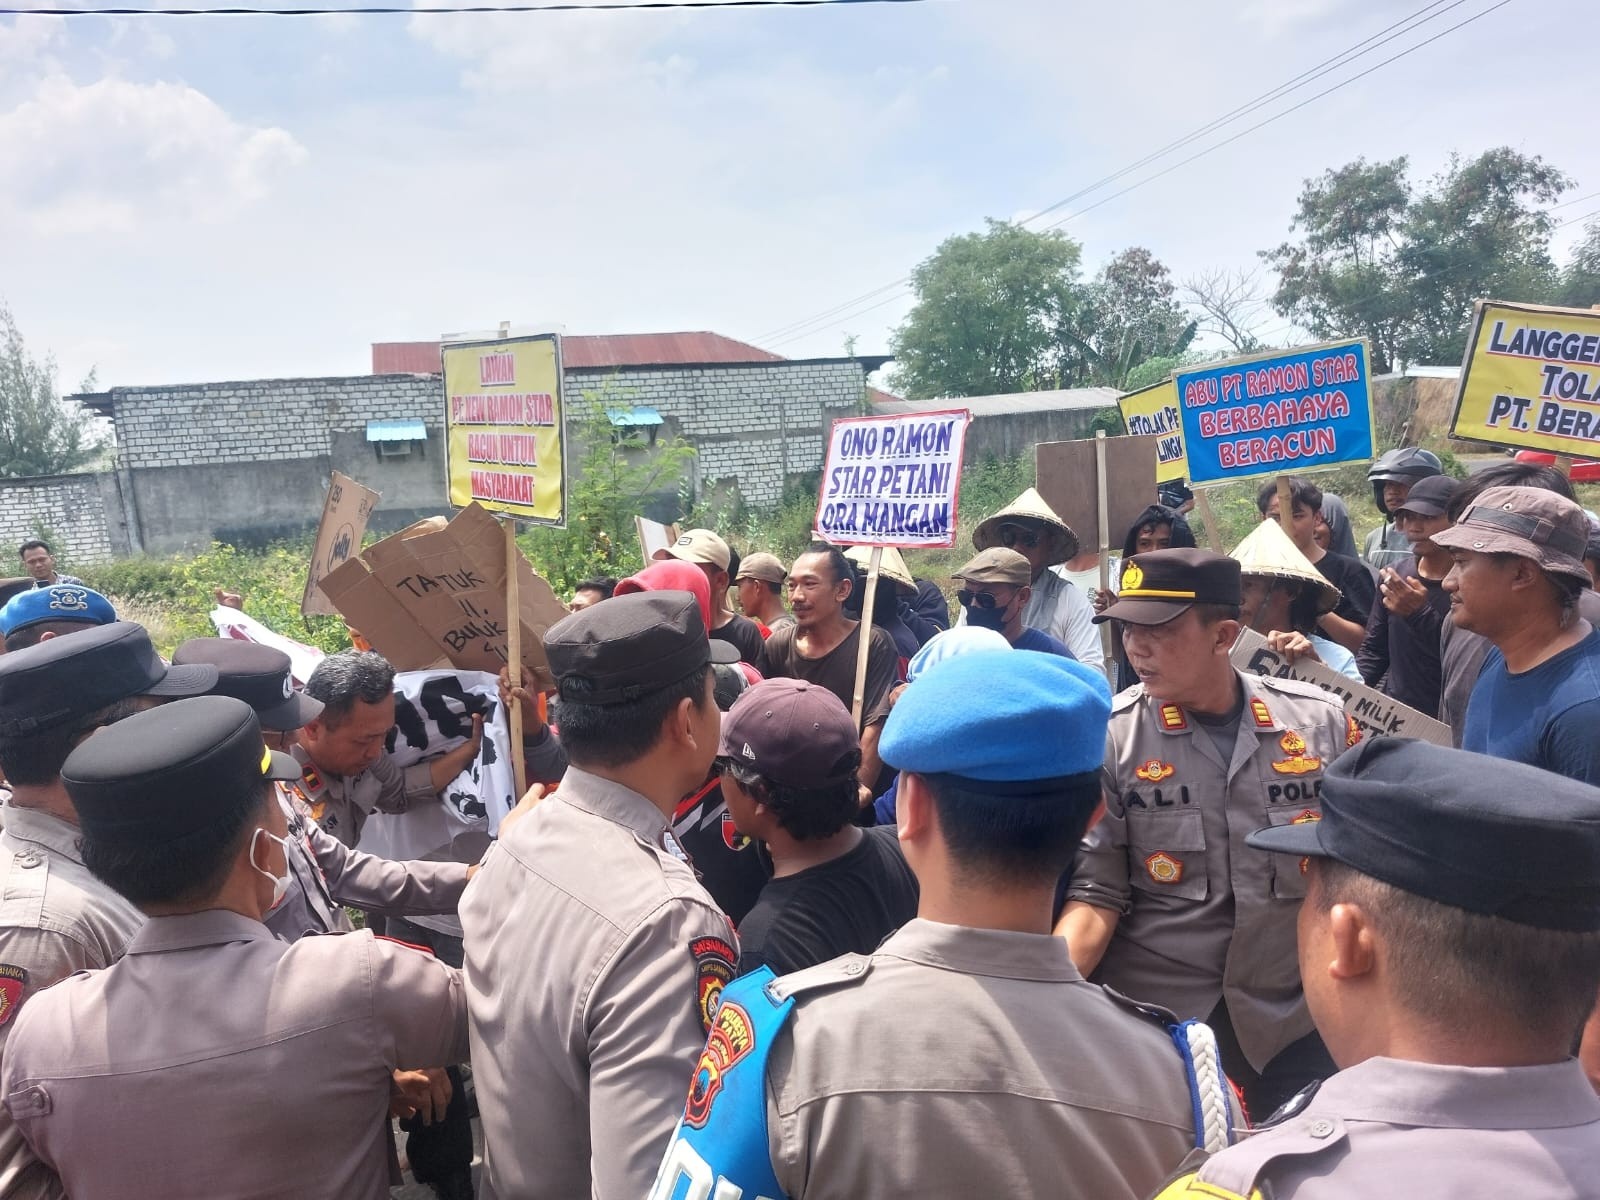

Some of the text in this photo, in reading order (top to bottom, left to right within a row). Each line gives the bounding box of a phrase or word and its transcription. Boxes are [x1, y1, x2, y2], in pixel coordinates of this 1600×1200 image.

[1185, 354, 1359, 407] ABU PT RAMON STAR
[487, 394, 523, 425] RAMON
[526, 393, 554, 426] STAR
[1198, 391, 1349, 438] BERBAHAYA
[1489, 396, 1531, 430] PT.
[500, 434, 537, 466] UNTUK
[841, 421, 954, 457] ONO RAMON
[1218, 427, 1336, 469] BERACUN
[471, 472, 534, 506] MASYARAKAT
[828, 462, 952, 495] STAR PETANI
[822, 502, 949, 534] ORA MANGAN
[1127, 785, 1191, 809] ALI
